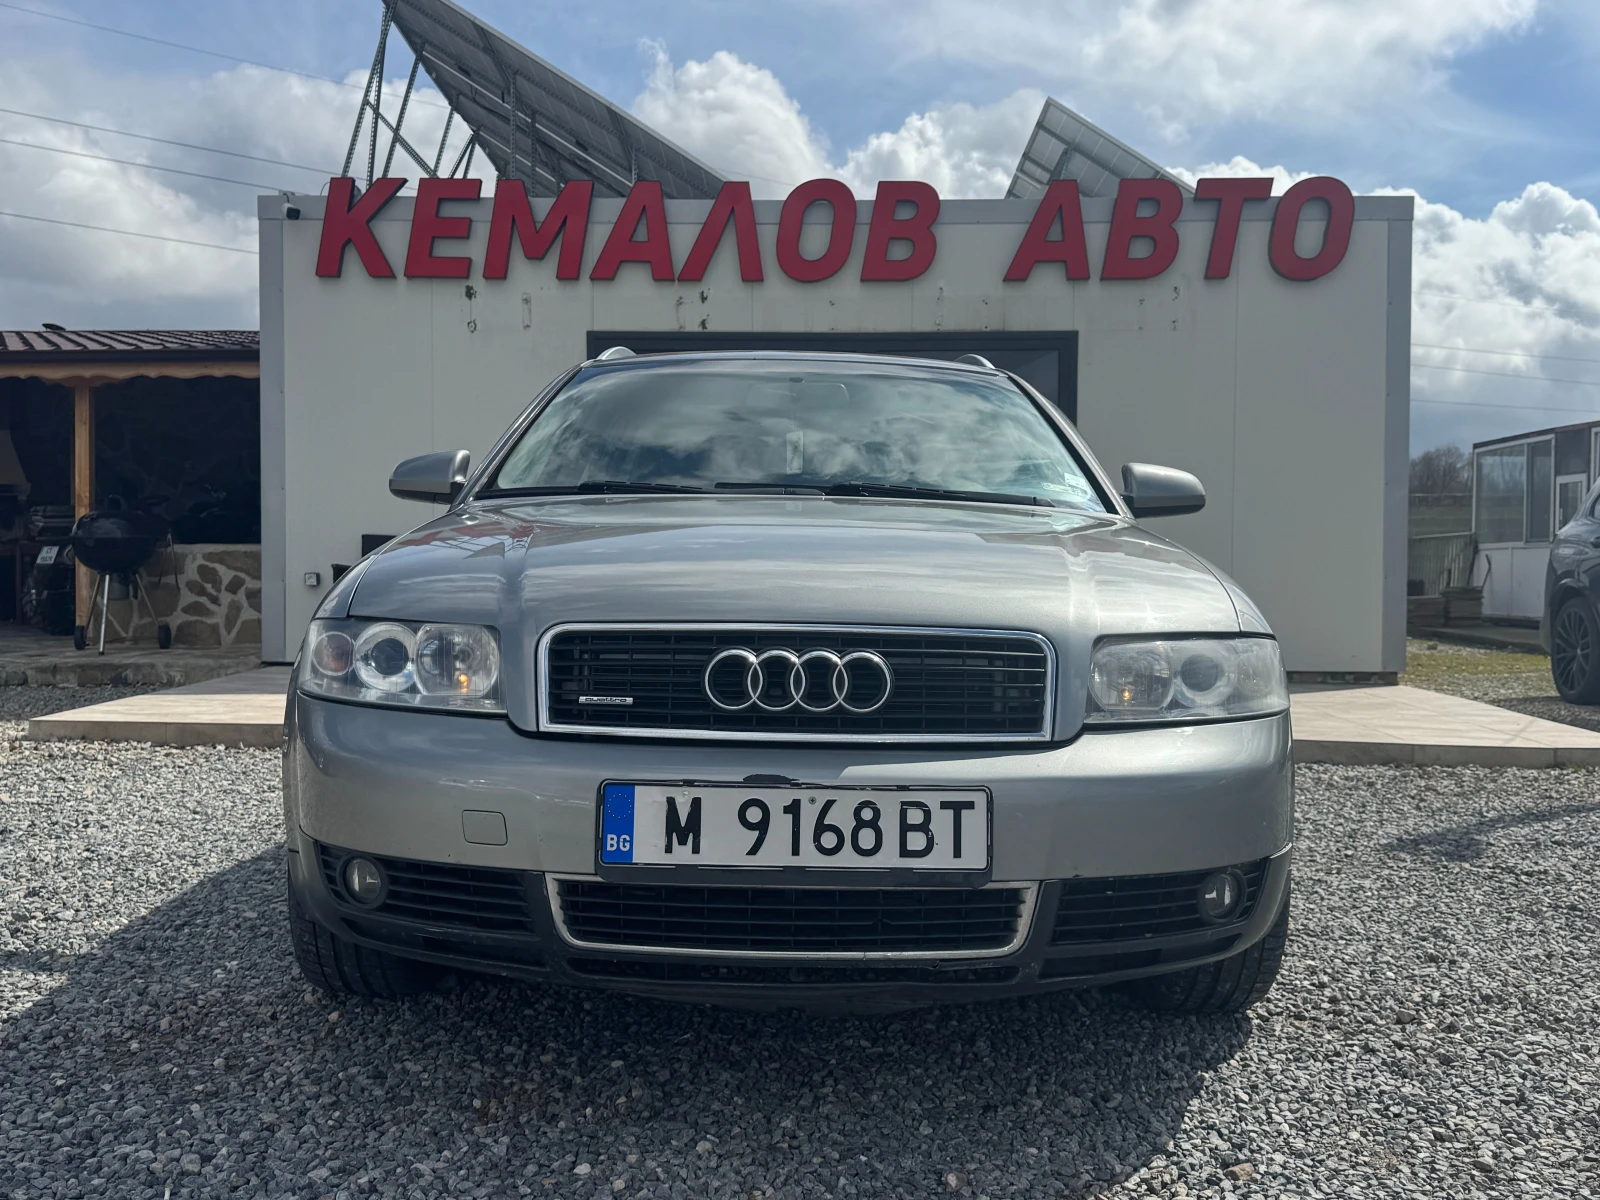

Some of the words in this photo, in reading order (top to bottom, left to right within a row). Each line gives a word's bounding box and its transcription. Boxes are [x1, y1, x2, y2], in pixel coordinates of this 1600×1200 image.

[315, 177, 942, 283] КЕМАЛОВ
[1003, 176, 1356, 282] АВТО
[606, 834, 631, 851] BG
[664, 796, 702, 855] M
